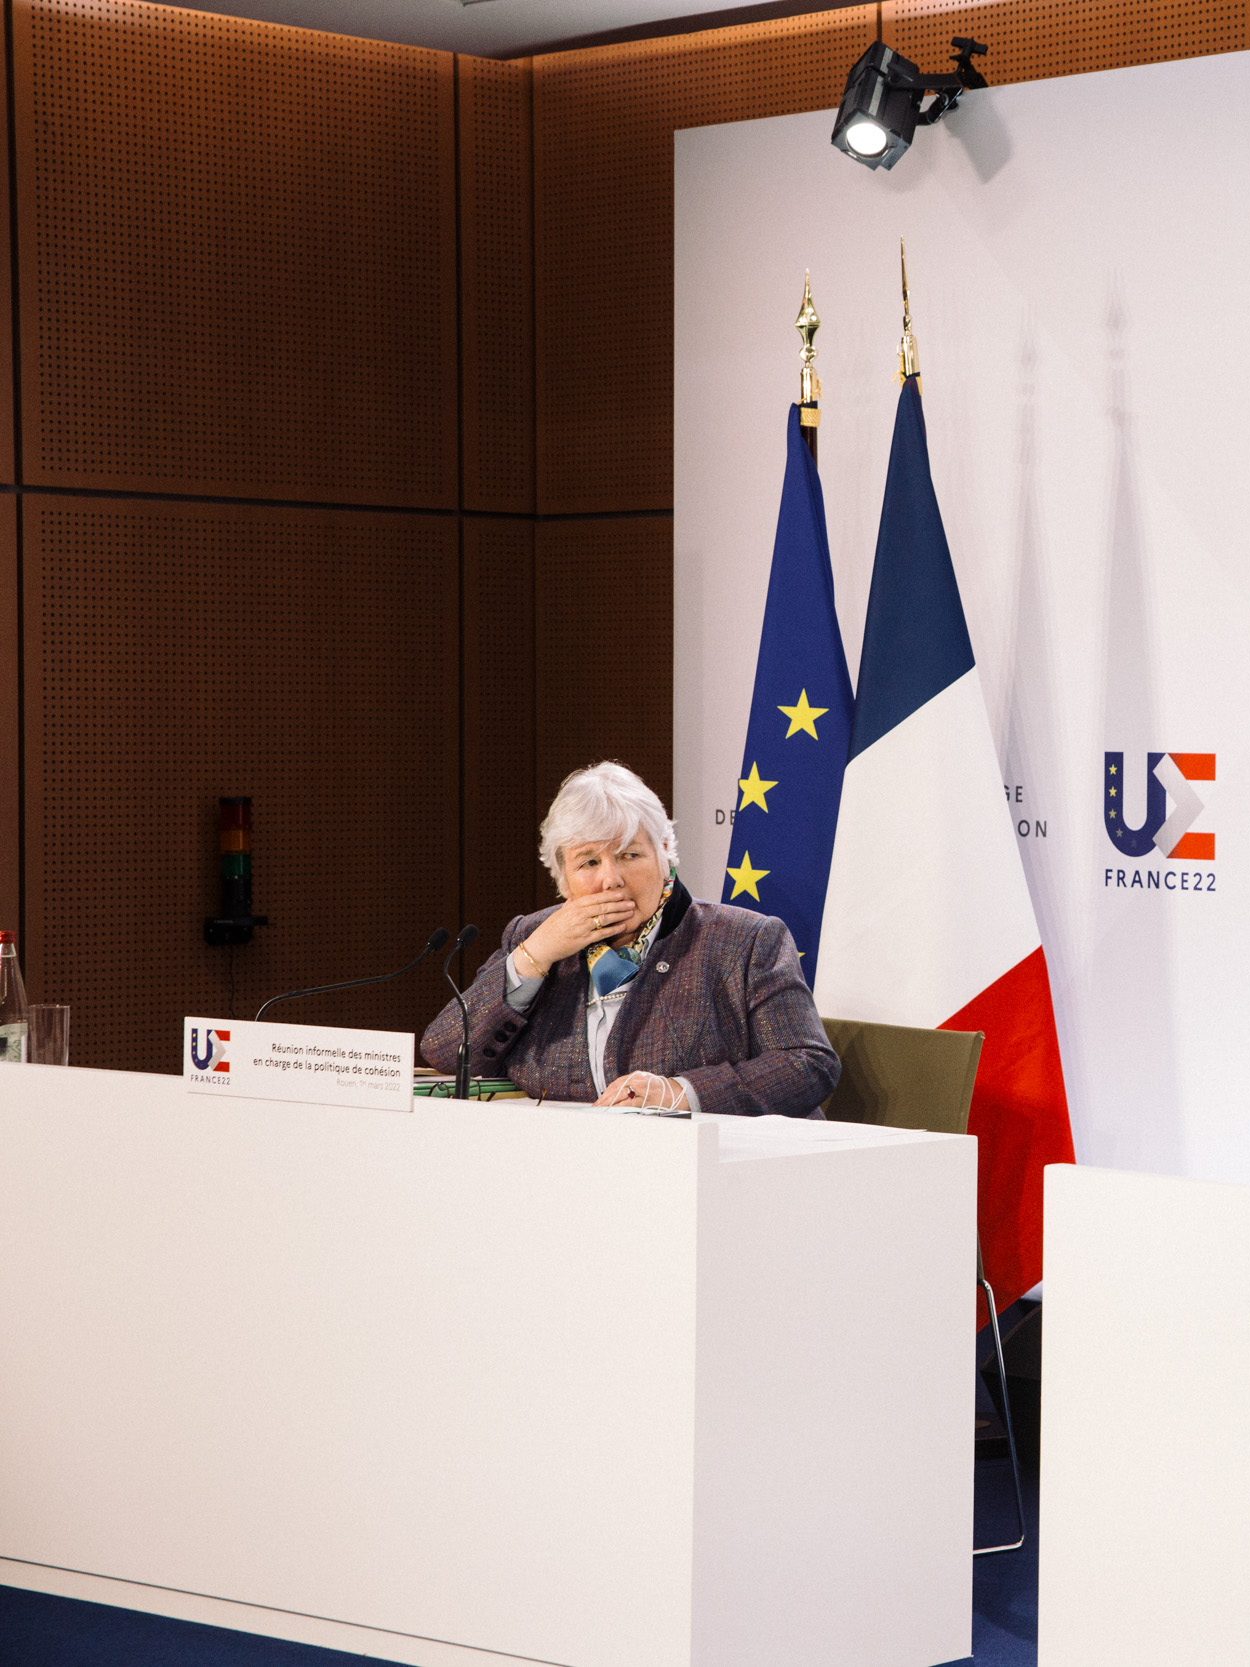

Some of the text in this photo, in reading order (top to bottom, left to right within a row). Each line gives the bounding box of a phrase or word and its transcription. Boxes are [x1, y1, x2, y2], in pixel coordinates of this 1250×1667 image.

[1105, 869, 1215, 891] FRANCE22
[272, 1043, 401, 1062] Réunion informelle des ministres
[265, 1058, 291, 1070] charge
[293, 1060, 303, 1068] de
[305, 1060, 312, 1069] la
[314, 1062, 350, 1075] politique
[352, 1064, 362, 1073] de
[364, 1065, 401, 1077] cohésion
[190, 1074, 231, 1085] FRANCE22
[336, 1079, 358, 1088] Rouen,
[367, 1082, 384, 1090] mars
[385, 1081, 401, 1091] 2022
